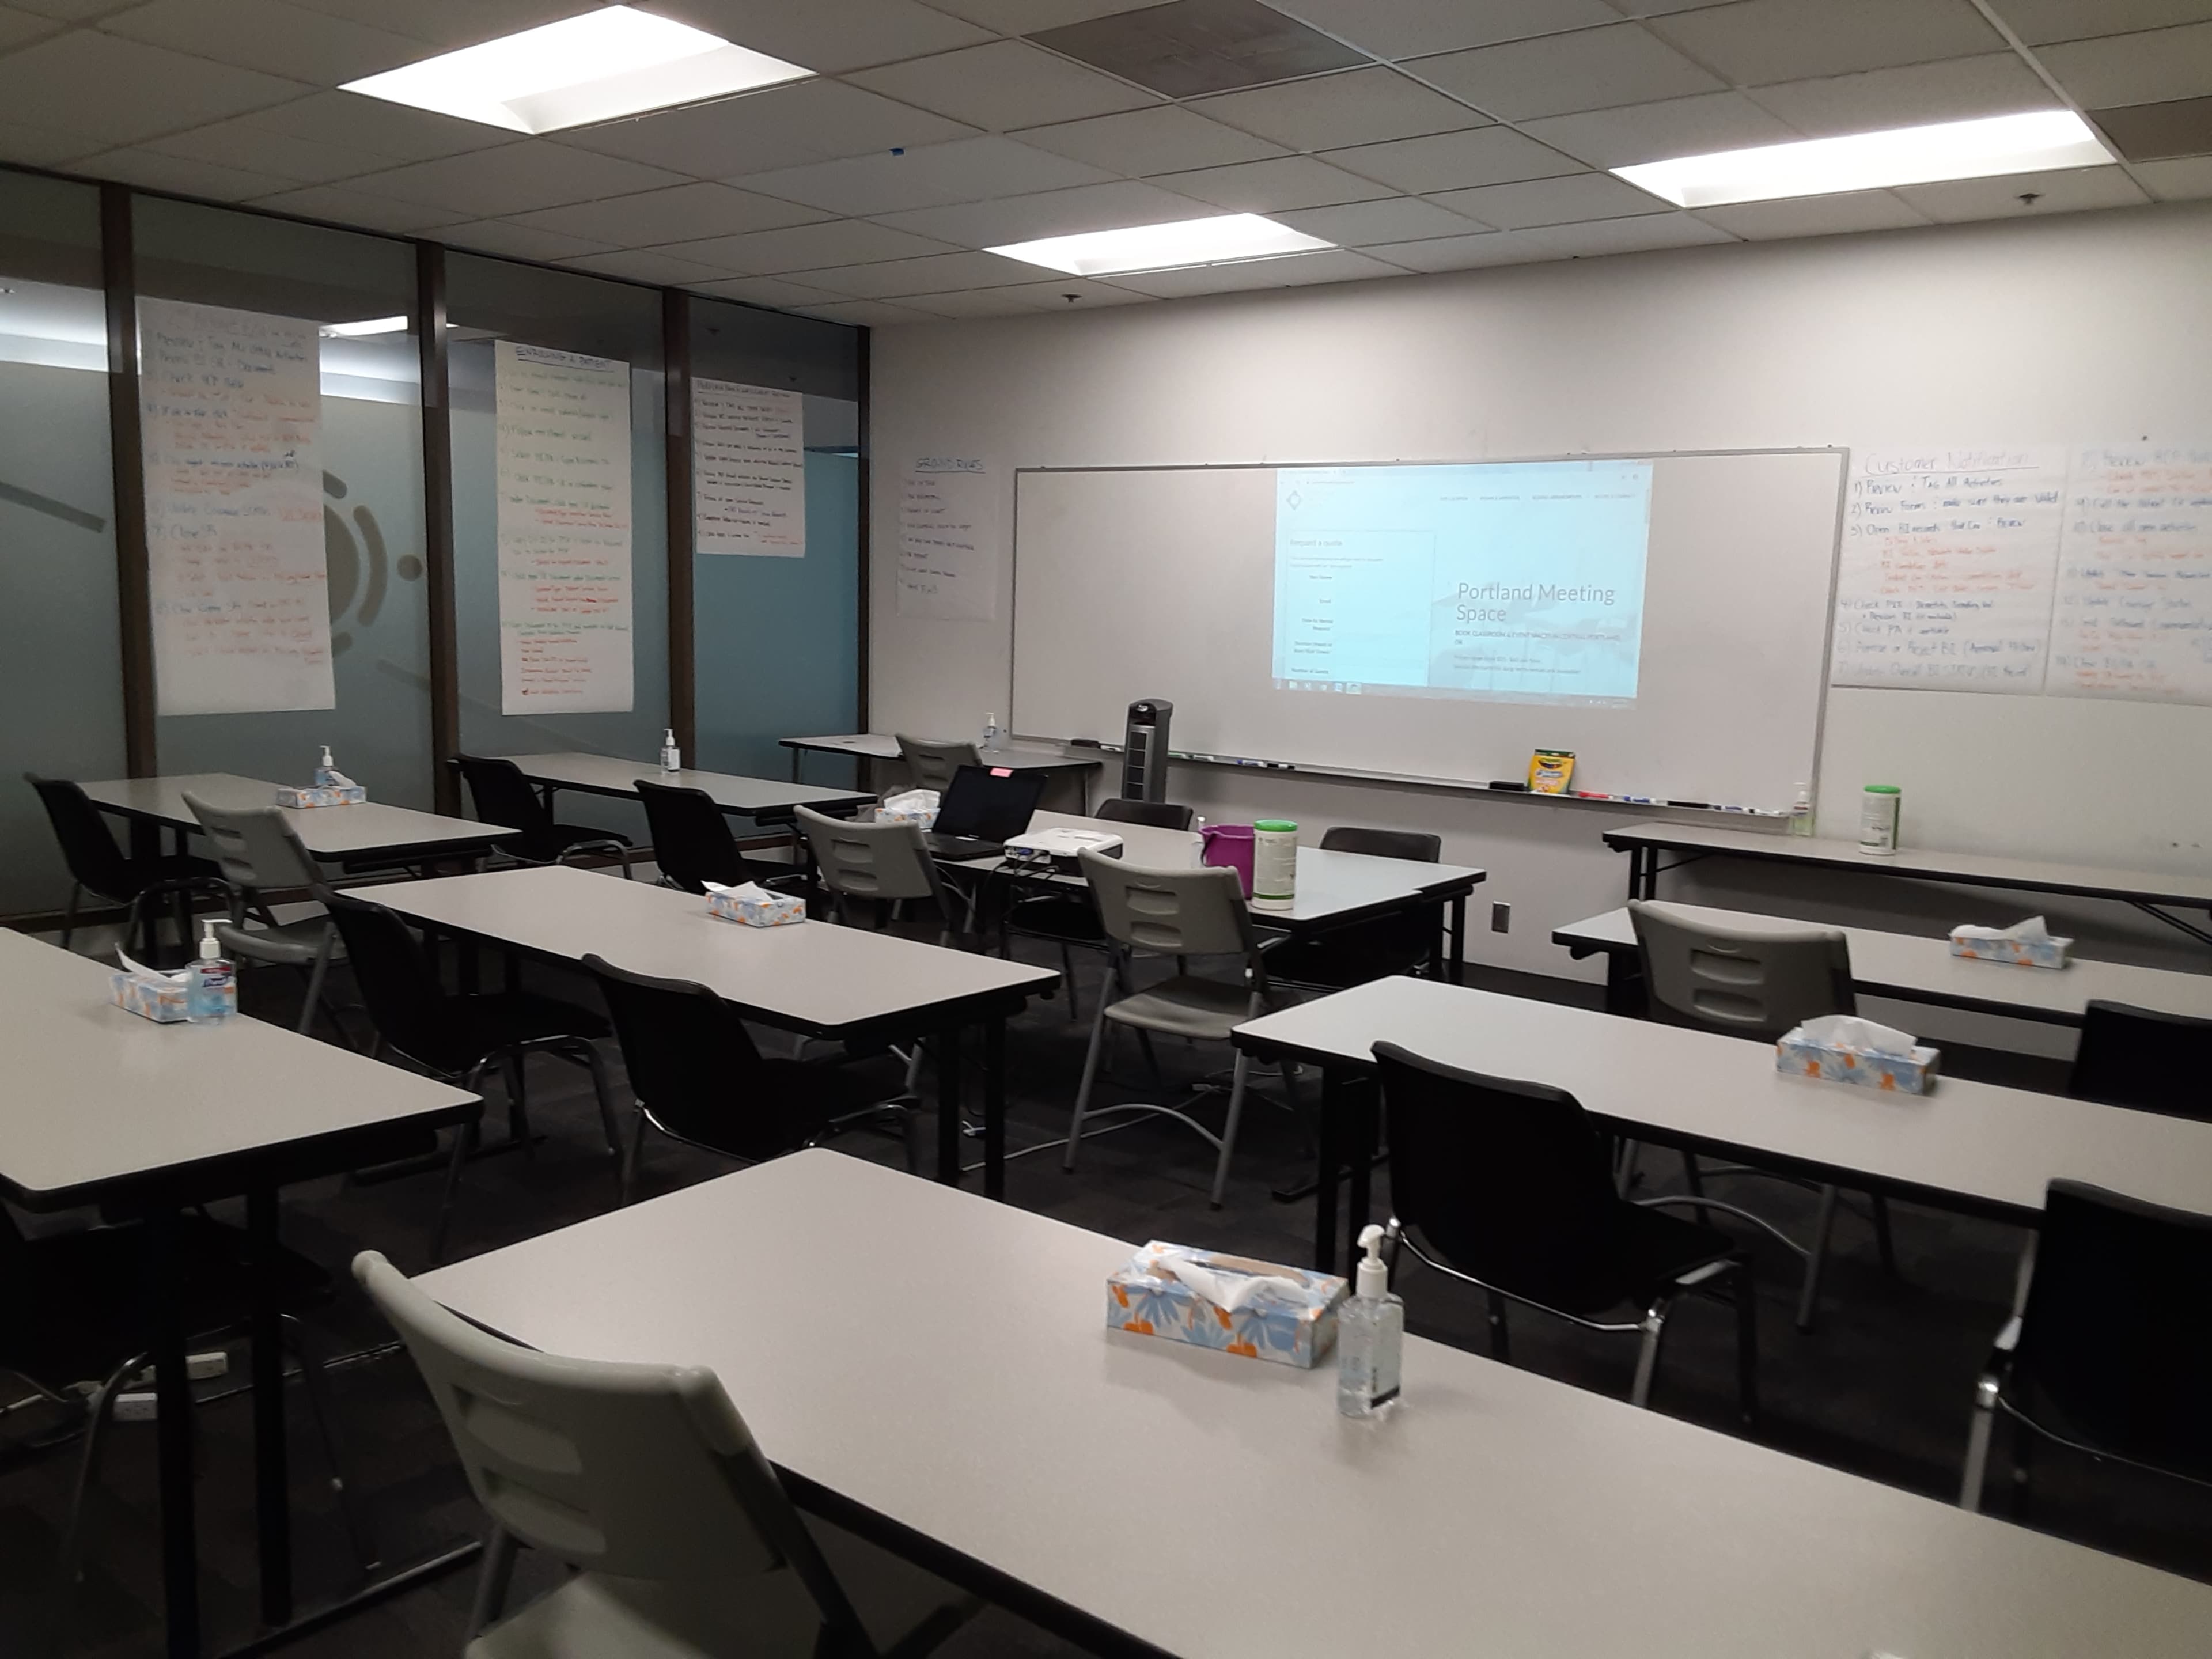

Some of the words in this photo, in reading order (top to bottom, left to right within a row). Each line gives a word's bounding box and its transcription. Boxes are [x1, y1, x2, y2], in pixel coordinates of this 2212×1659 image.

[1457, 582, 1533, 600] Portland
[1538, 584, 1615, 606] Meeting
[1456, 604, 1507, 623] Space
